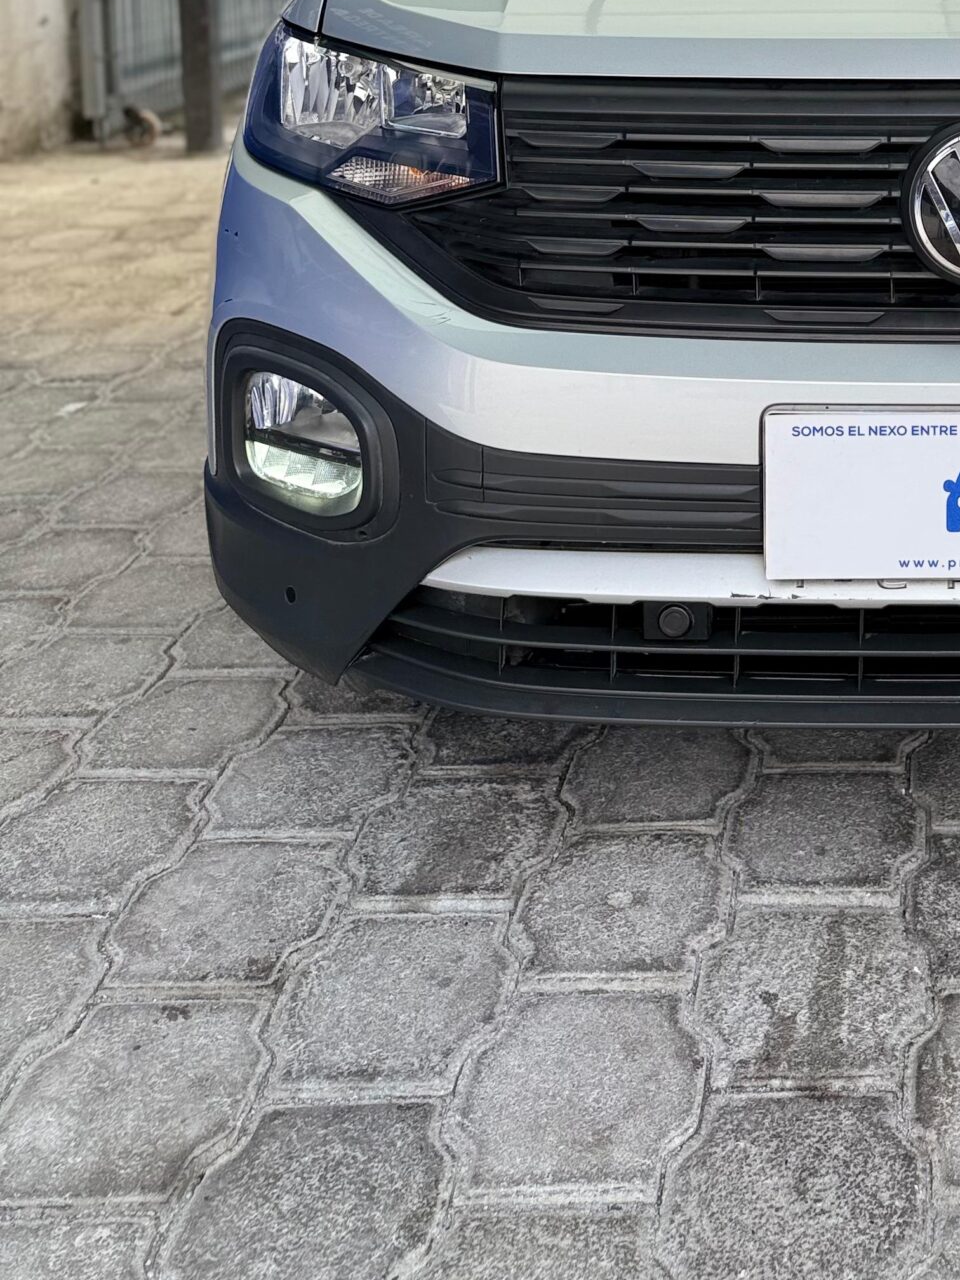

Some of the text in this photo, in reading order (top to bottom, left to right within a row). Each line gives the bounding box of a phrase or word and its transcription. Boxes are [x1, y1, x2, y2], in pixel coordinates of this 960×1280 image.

[791, 425, 844, 437] SOMOS
[848, 425, 865, 437] EL
[868, 425, 907, 437] NEXO
[911, 425, 958, 436] ENTRE
